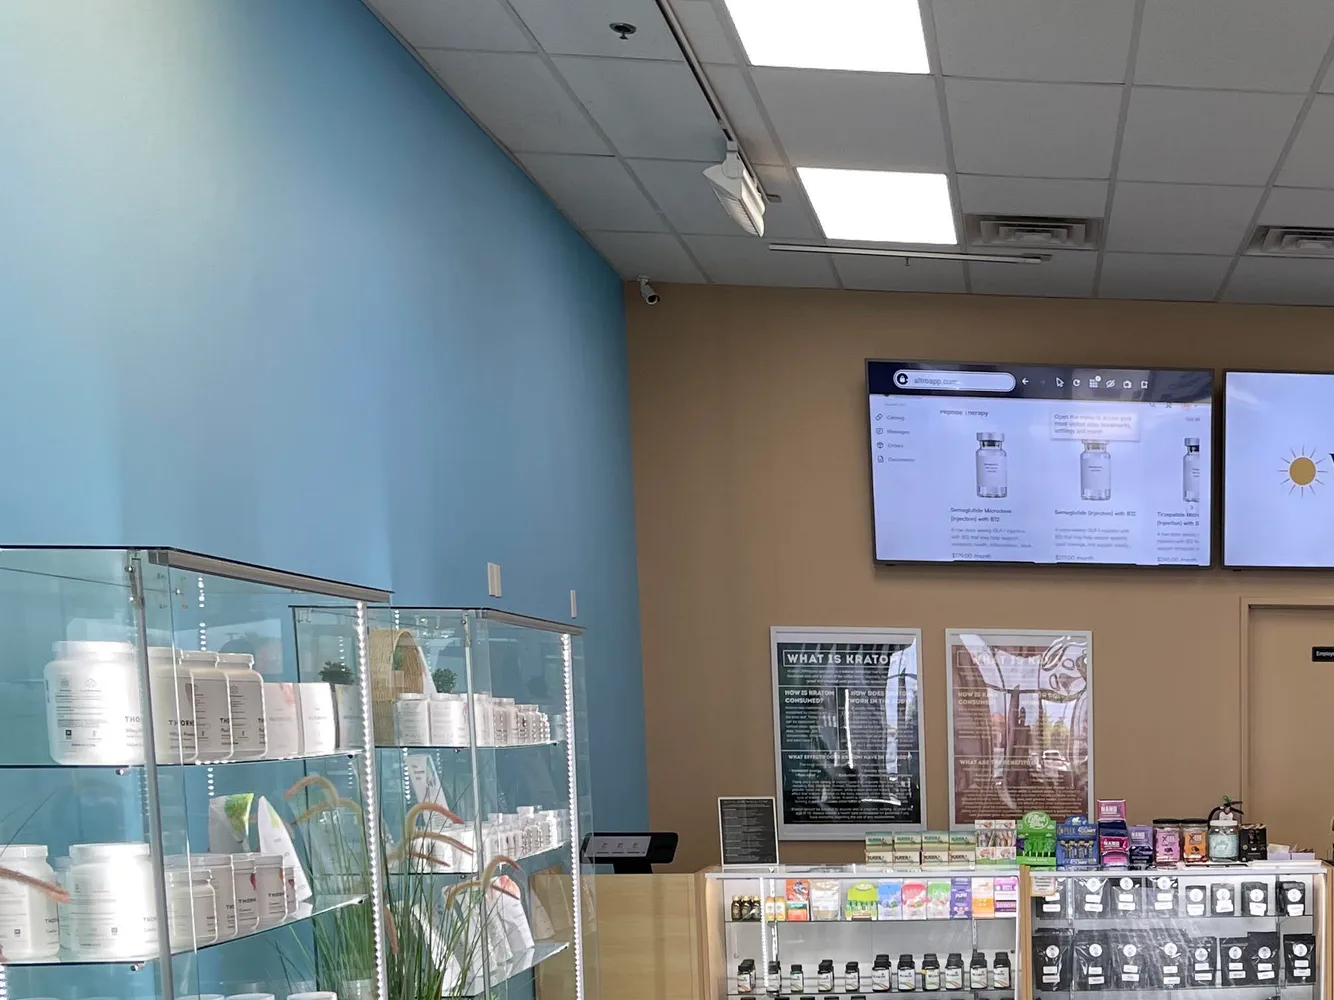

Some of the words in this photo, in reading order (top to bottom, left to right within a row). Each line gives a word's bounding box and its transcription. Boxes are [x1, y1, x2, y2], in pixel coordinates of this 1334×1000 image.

[787, 653, 824, 664] WHAT
[828, 654, 841, 664] IS
[846, 654, 898, 665] KRATO
